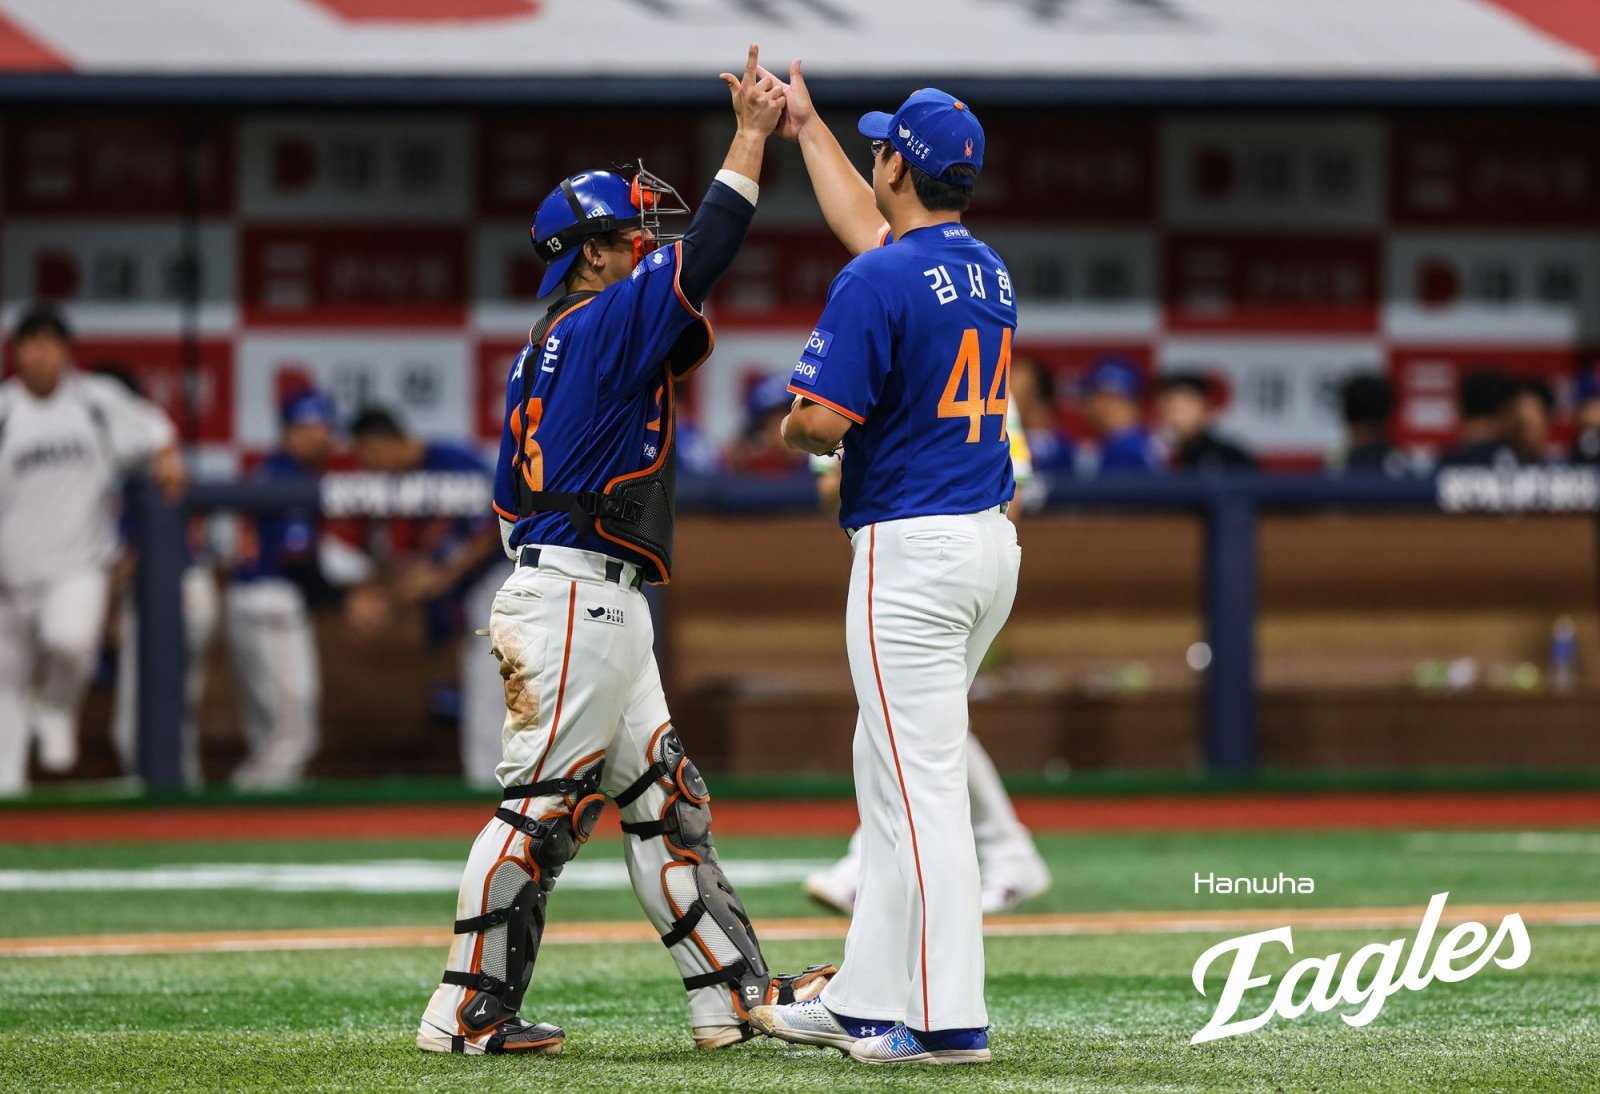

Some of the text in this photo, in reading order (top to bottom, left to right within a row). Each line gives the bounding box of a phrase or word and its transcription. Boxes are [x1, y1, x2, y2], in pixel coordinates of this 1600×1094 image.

[906, 141, 925, 159] PLUS
[910, 135, 930, 154] LIFE
[546, 237, 562, 252] 13
[937, 327, 1012, 443] 44
[745, 985, 760, 1001] 13
